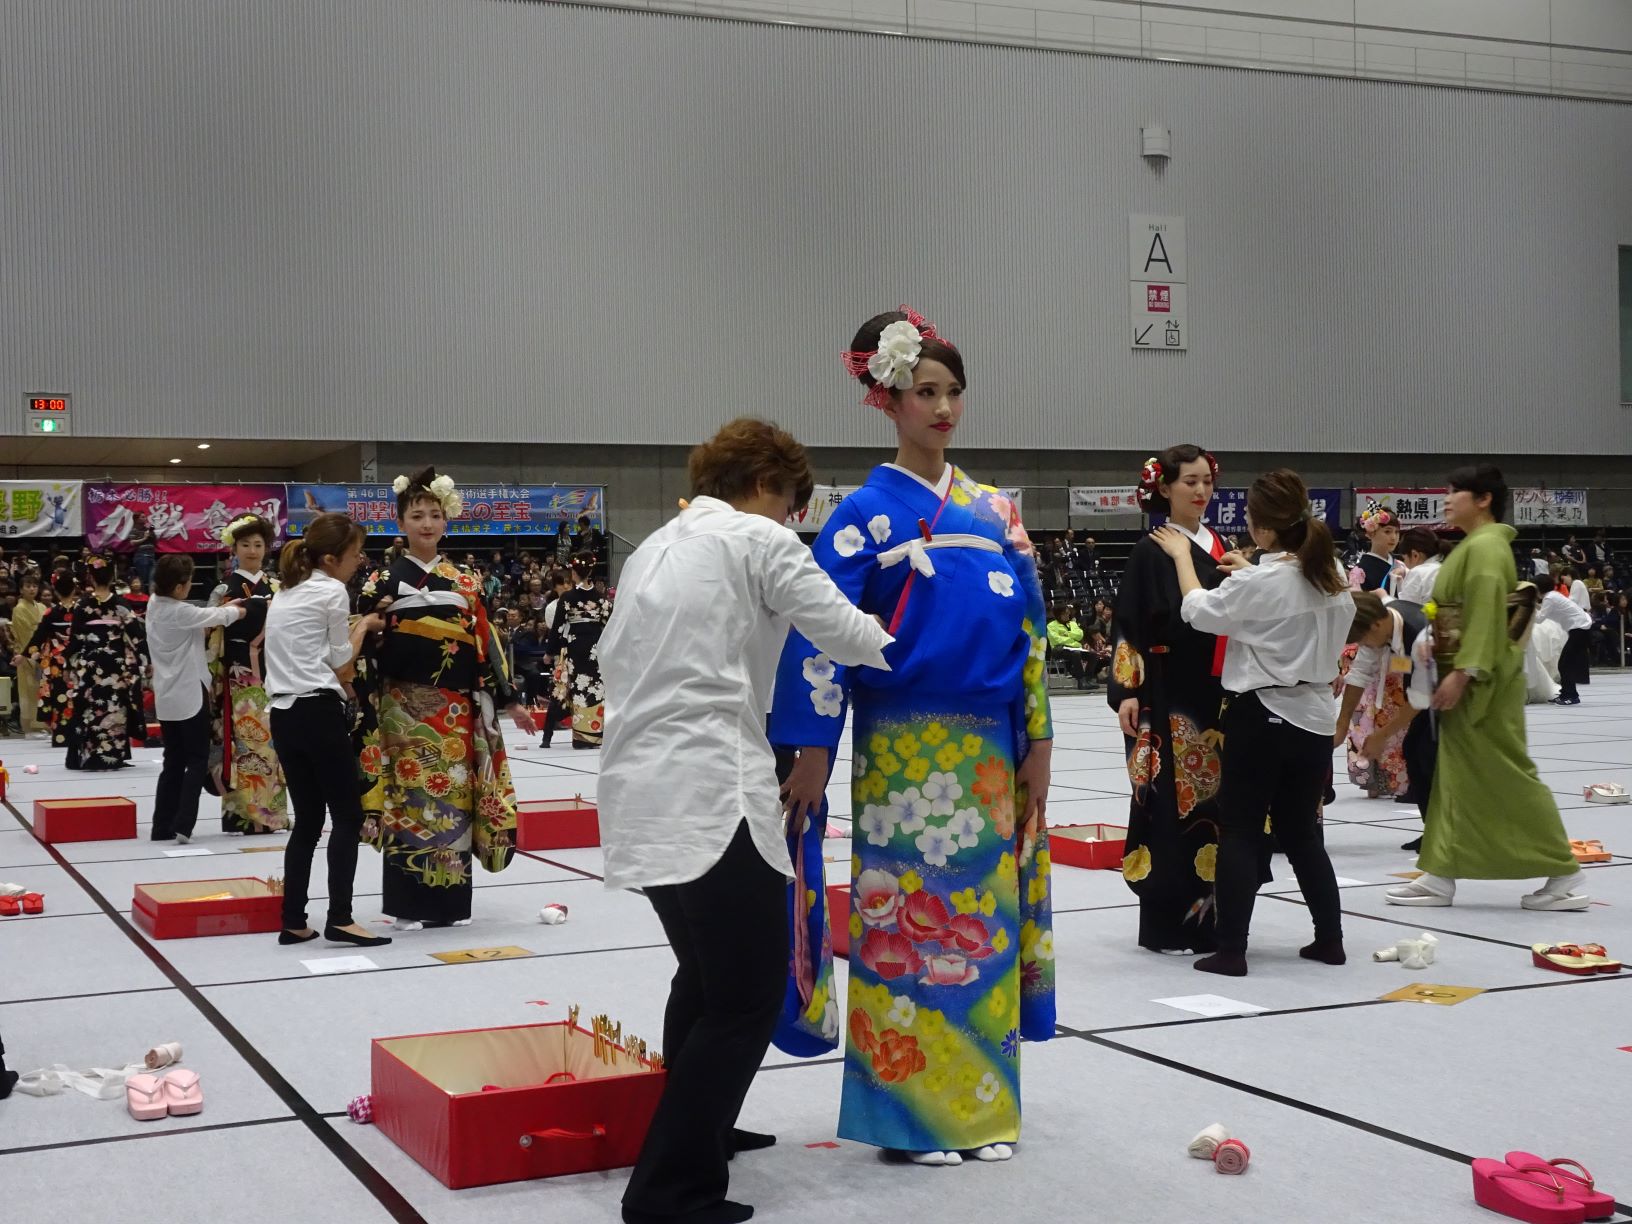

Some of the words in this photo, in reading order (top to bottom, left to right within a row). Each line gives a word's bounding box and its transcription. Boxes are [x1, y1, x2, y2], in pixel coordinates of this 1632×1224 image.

[1148, 223, 1167, 231] Hall
[1144, 232, 1172, 273] A
[34, 399, 64, 410] 13:00
[0, 489, 44, 523] 野
